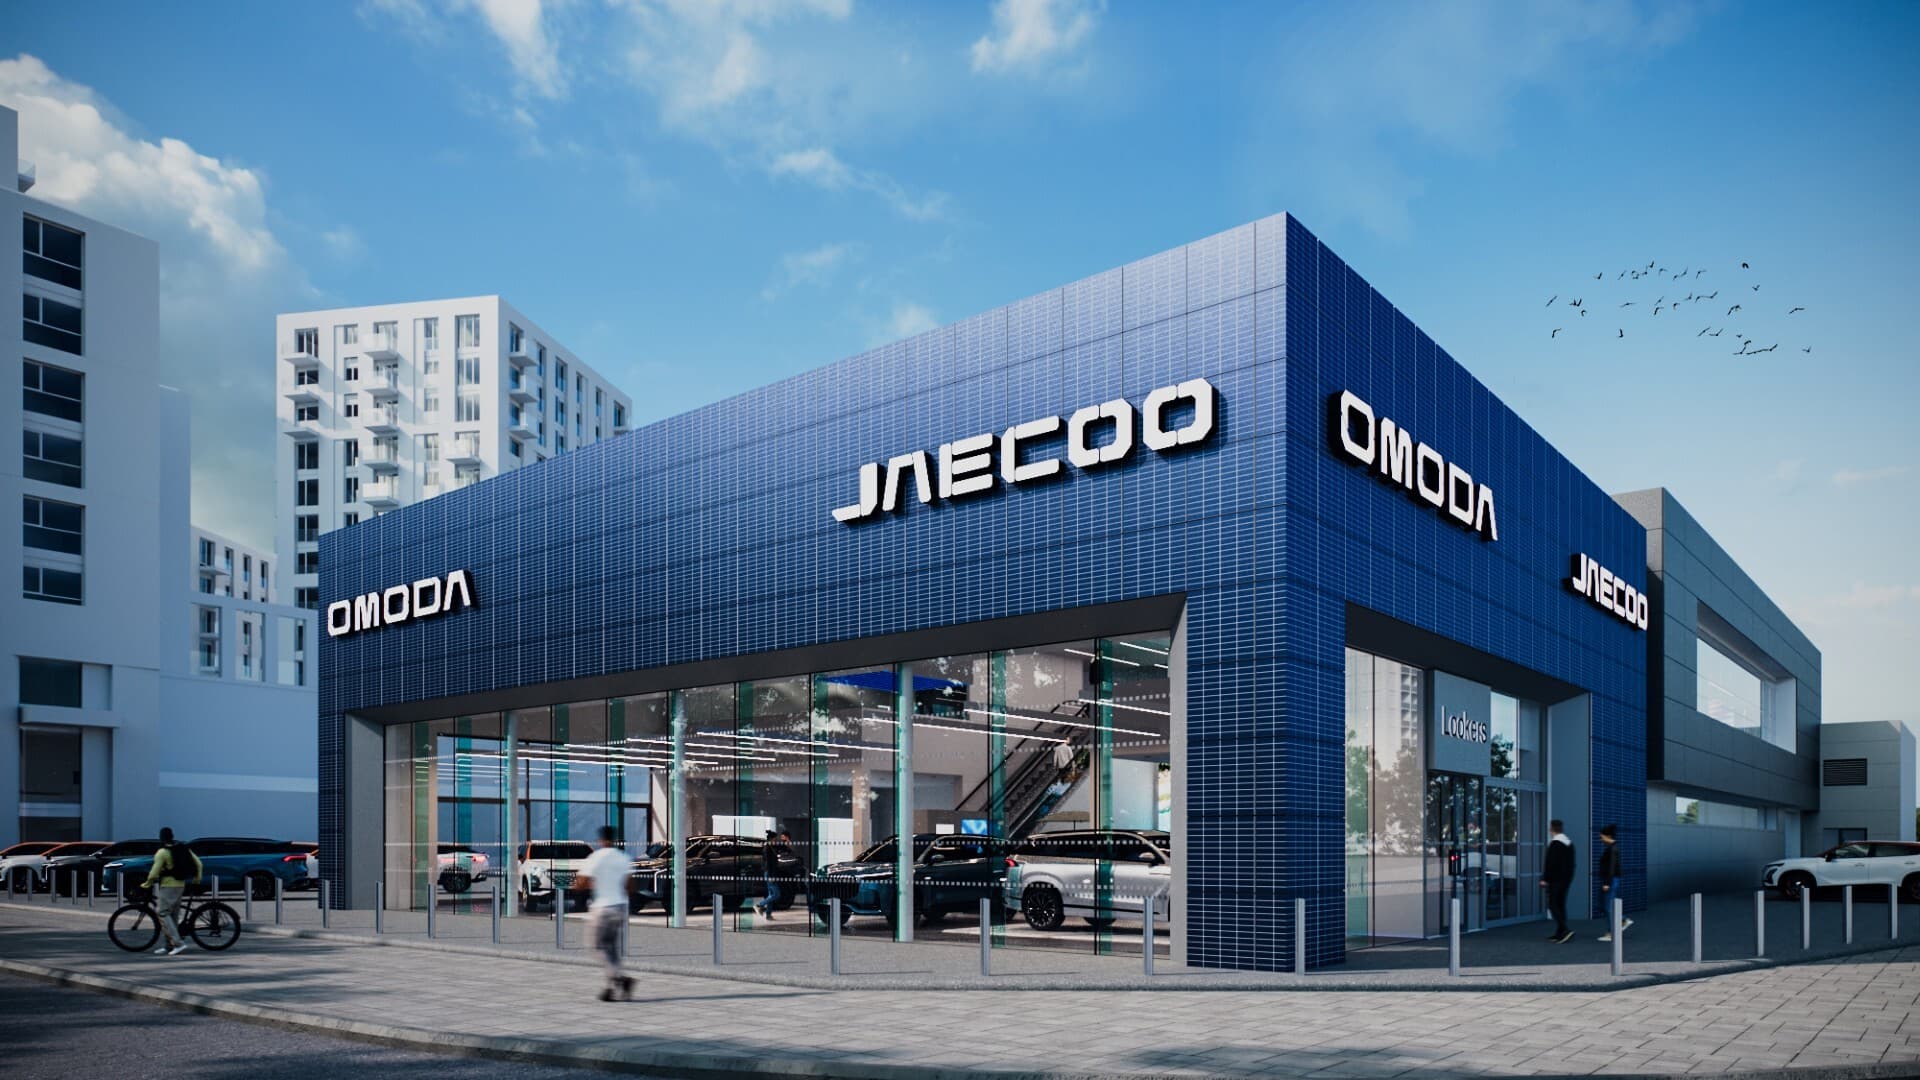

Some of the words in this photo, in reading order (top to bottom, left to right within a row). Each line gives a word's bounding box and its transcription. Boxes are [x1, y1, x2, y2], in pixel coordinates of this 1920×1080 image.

[832, 377, 1213, 522] JAECOO
[1341, 389, 1498, 541] OMODA
[327, 569, 471, 637] OMODA
[1572, 552, 1648, 631] JAECOO
[1441, 705, 1487, 744] Lookers
